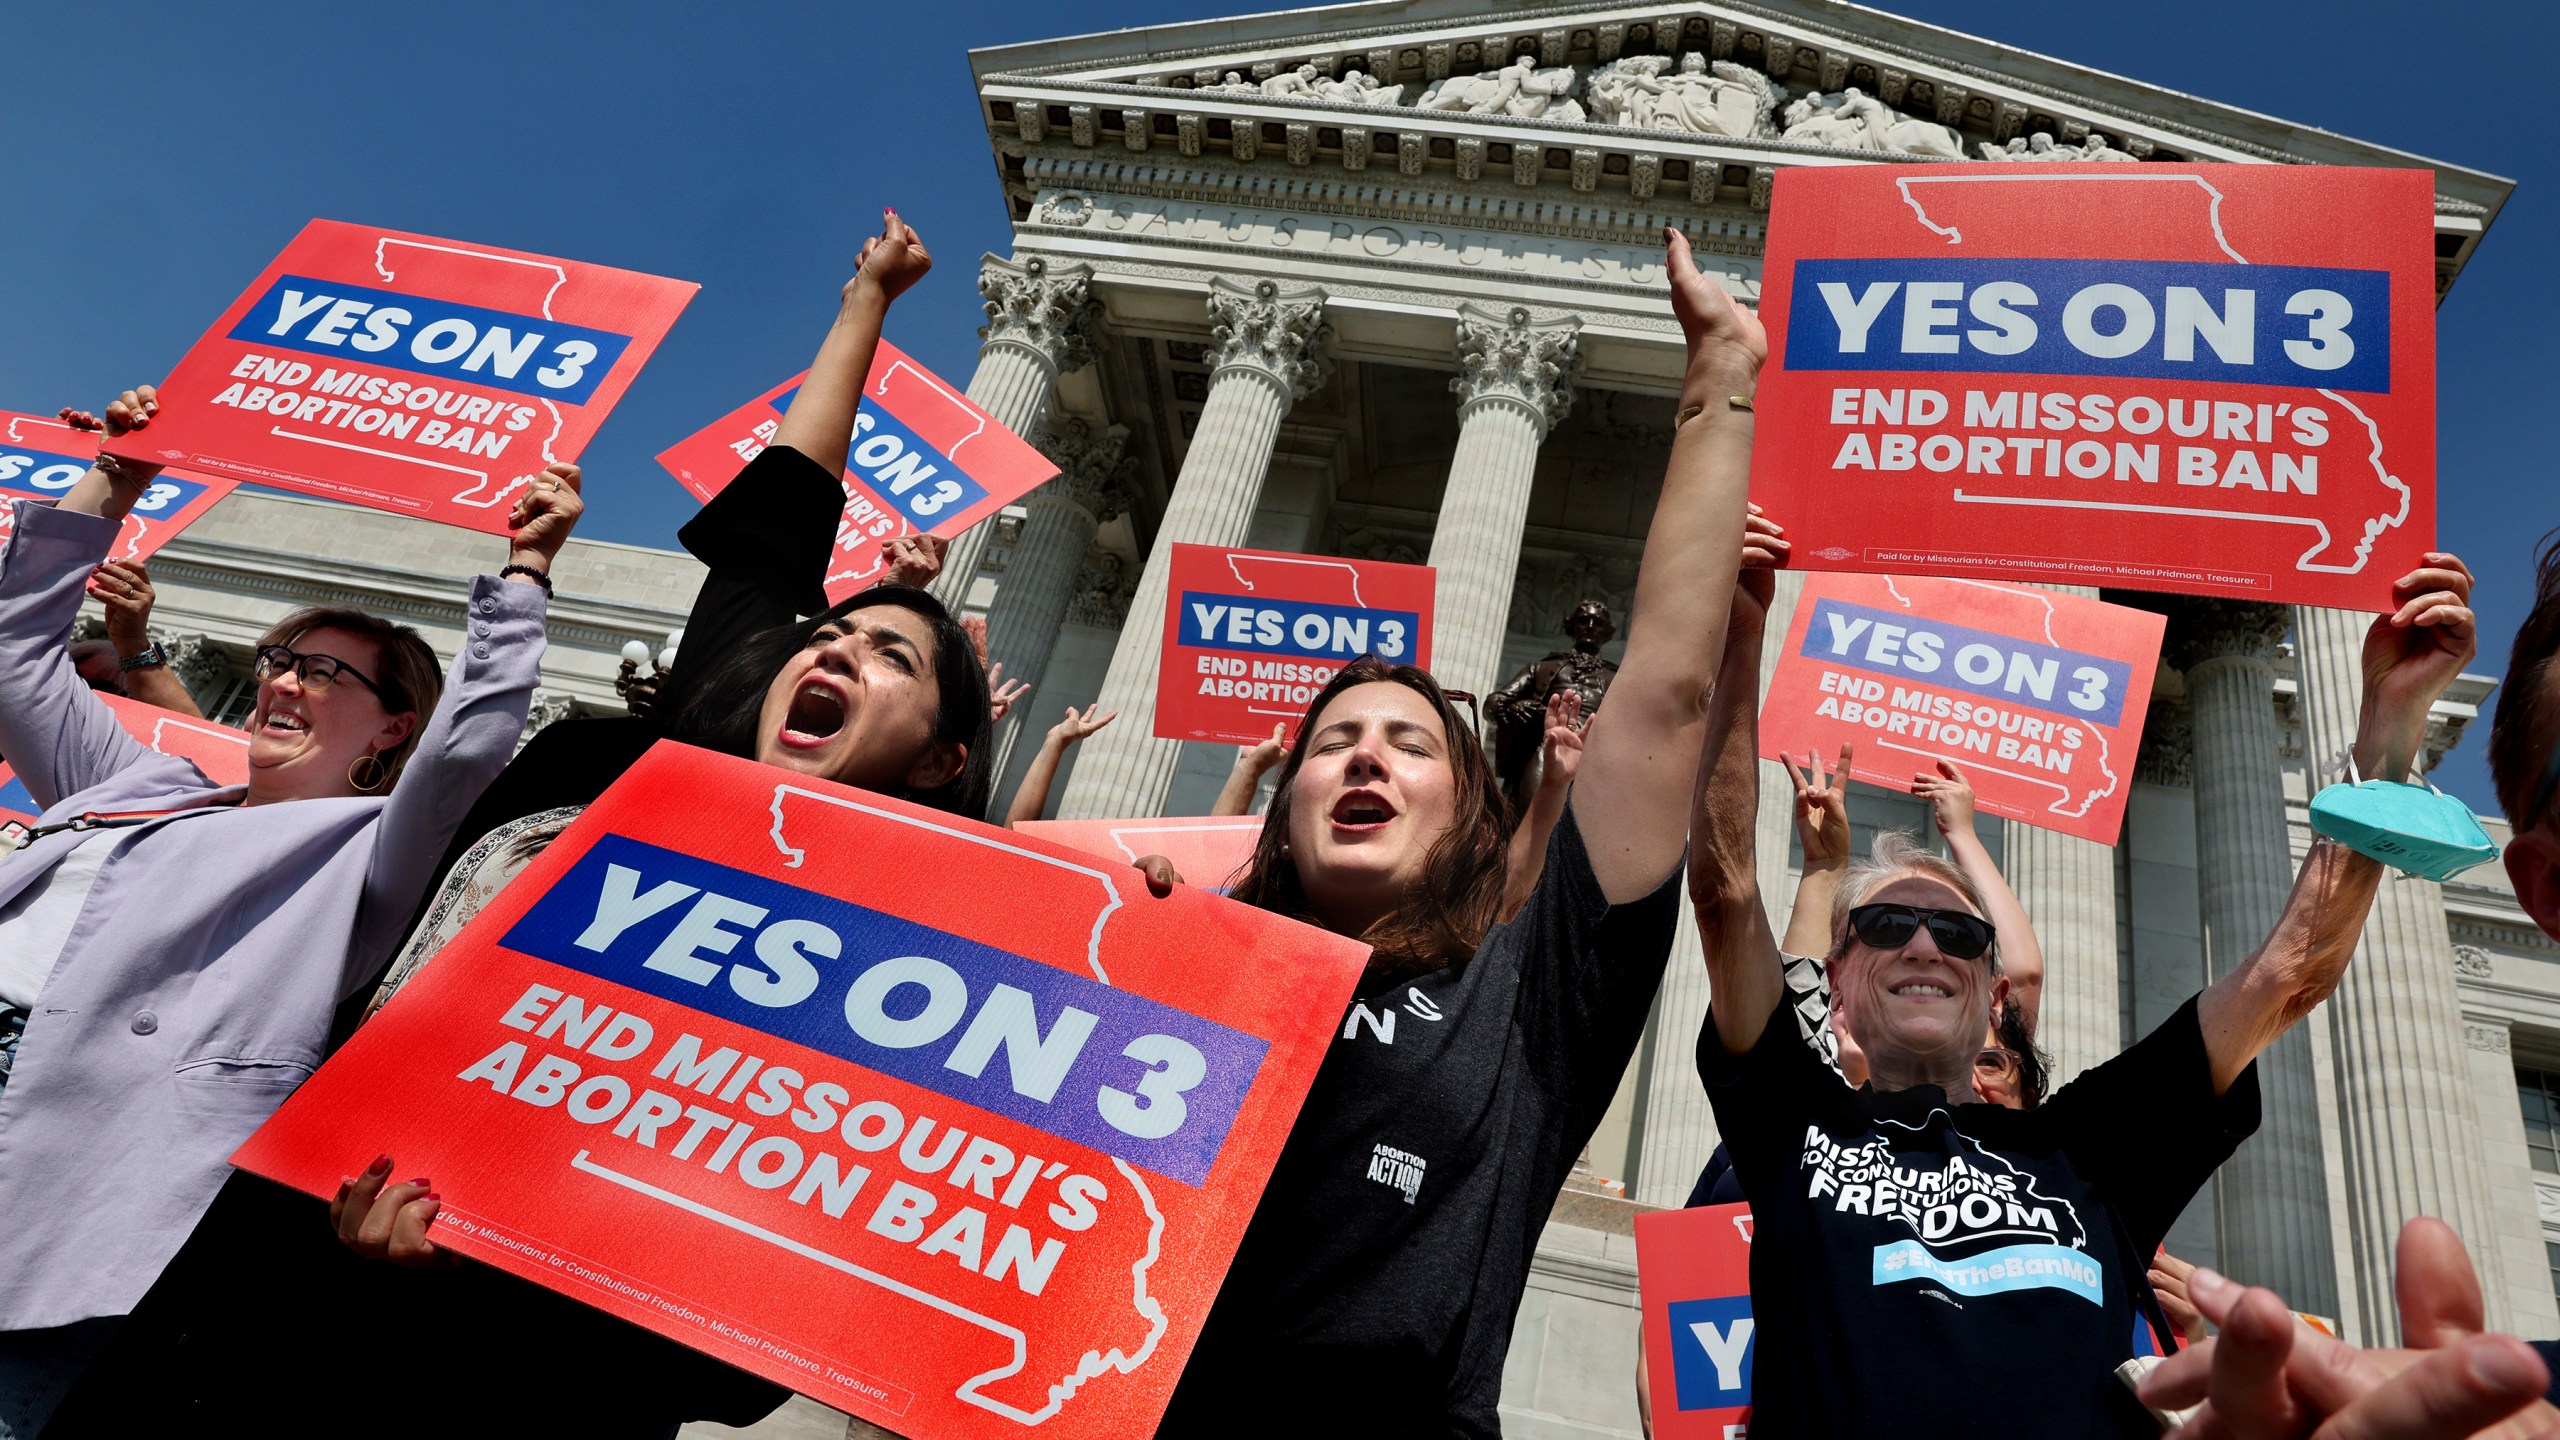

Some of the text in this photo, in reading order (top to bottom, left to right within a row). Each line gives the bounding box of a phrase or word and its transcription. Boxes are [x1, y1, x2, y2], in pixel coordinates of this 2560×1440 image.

[1106, 200, 1299, 248] SALUS
[1324, 220, 1556, 278] POPULI
[267, 289, 598, 388] YES ON 3
[1816, 281, 2356, 371] YES ON 3
[211, 382, 513, 459] ABORTION BAN
[230, 353, 537, 432] END MISSOURI'S
[1829, 387, 2330, 447] END MISSOURI'S
[29, 464, 87, 490] O
[133, 483, 181, 511] 3
[227, 463, 262, 476] Missourians
[270, 472, 311, 485] Constitutional
[338, 486, 362, 495] Michael
[853, 434, 963, 516] ON 3
[1831, 432, 2319, 495] ABORTION BAN
[1876, 551, 2257, 586] Paid for by Missourians for Constitutional Freedom, Michael Pridmore, Treasurer.
[1192, 603, 1405, 657] YES ON 3
[1197, 655, 1248, 677] END
[1826, 612, 2110, 712] YES ON 3
[1815, 697, 2074, 774] ABORTION BAN
[1818, 671, 2084, 749] END MISSOURI'S
[573, 862, 1208, 1141] YES ON 3
[498, 982, 1109, 1231] END MISSOURI'S
[456, 1040, 1068, 1297] ABORTION BAN
[1373, 1143, 1427, 1171] ABORTION
[1800, 1149, 1836, 1176] FOR
[445, 1212, 889, 1403] for by Missourians for Constitutional Freedom, Michael Pridmore, Treasurer.
